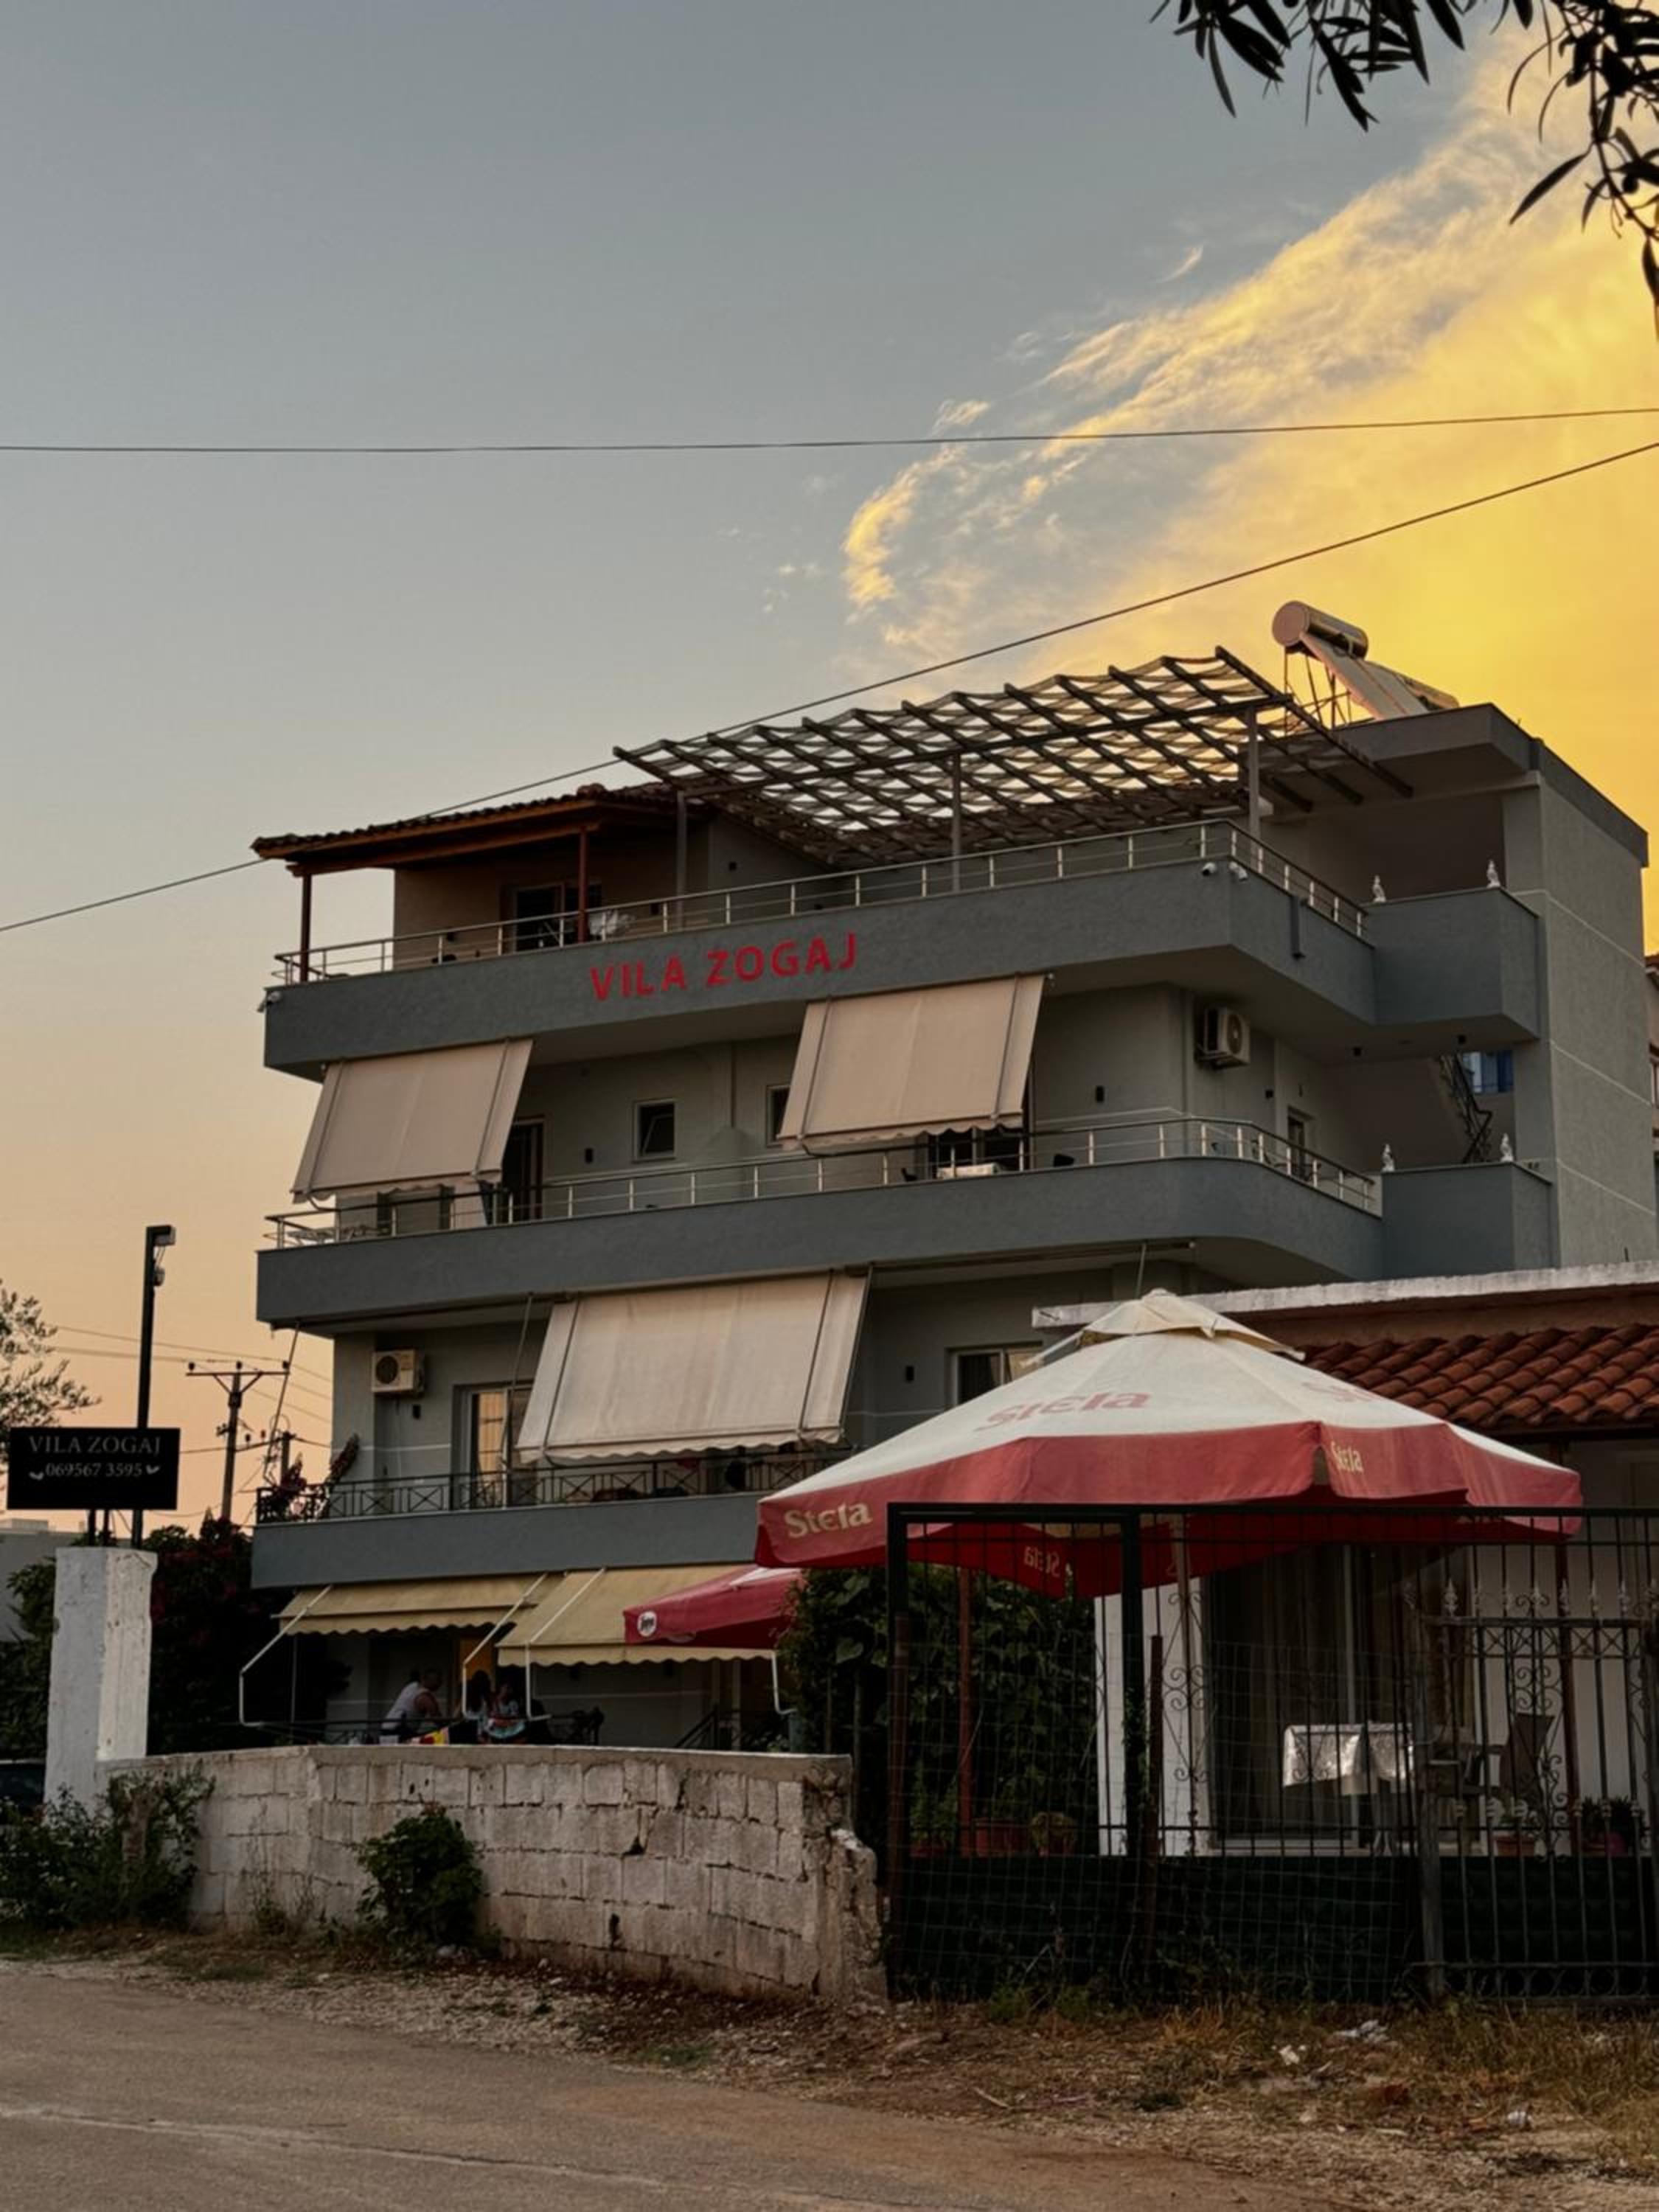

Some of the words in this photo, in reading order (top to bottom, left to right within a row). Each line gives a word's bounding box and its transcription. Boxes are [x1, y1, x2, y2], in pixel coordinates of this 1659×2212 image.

[591, 956, 686, 1001] VILA
[706, 931, 857, 987] ZOGAJ
[28, 1435, 82, 1454] VILA
[86, 1435, 161, 1457] ZOGAJ
[45, 1462, 102, 1478] 069567
[105, 1462, 143, 1478] 3595
[784, 1502, 874, 1539] Stela
